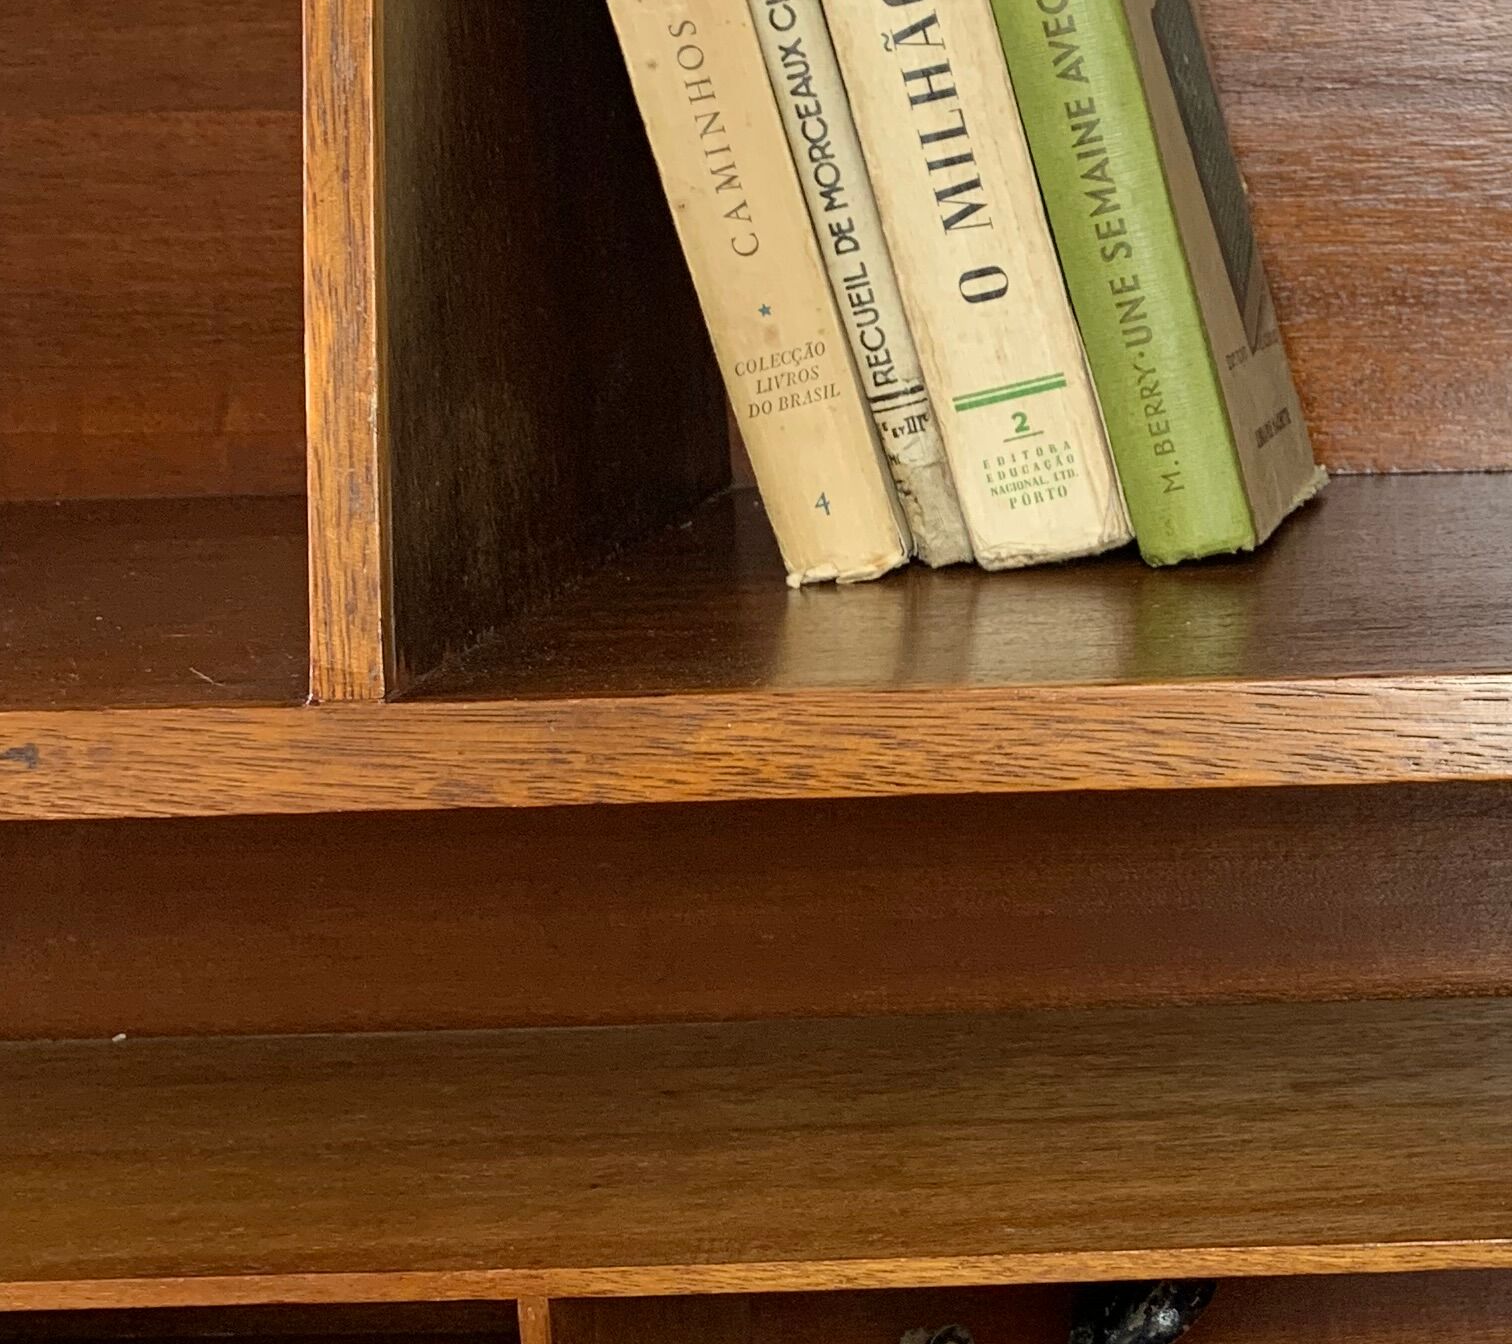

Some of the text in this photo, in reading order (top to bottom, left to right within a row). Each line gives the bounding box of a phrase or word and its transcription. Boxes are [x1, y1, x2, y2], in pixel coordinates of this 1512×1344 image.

[668, 20, 759, 257] CAMINHOS
[778, 37, 849, 213] MORCEAUX
[1064, 96, 1133, 263] SEMAINE
[828, 216, 861, 256] DE
[959, 265, 1009, 304] O
[843, 261, 898, 388] RECUEIL
[735, 341, 826, 377] COLECÇÃO
[756, 365, 820, 395] LIVROS
[748, 383, 841, 418] DO BRASIL
[1011, 411, 1030, 433] 2
[983, 440, 1071, 470] EDITORA
[986, 454, 1075, 484] EDUCAÇÃO
[815, 492, 831, 516] 4
